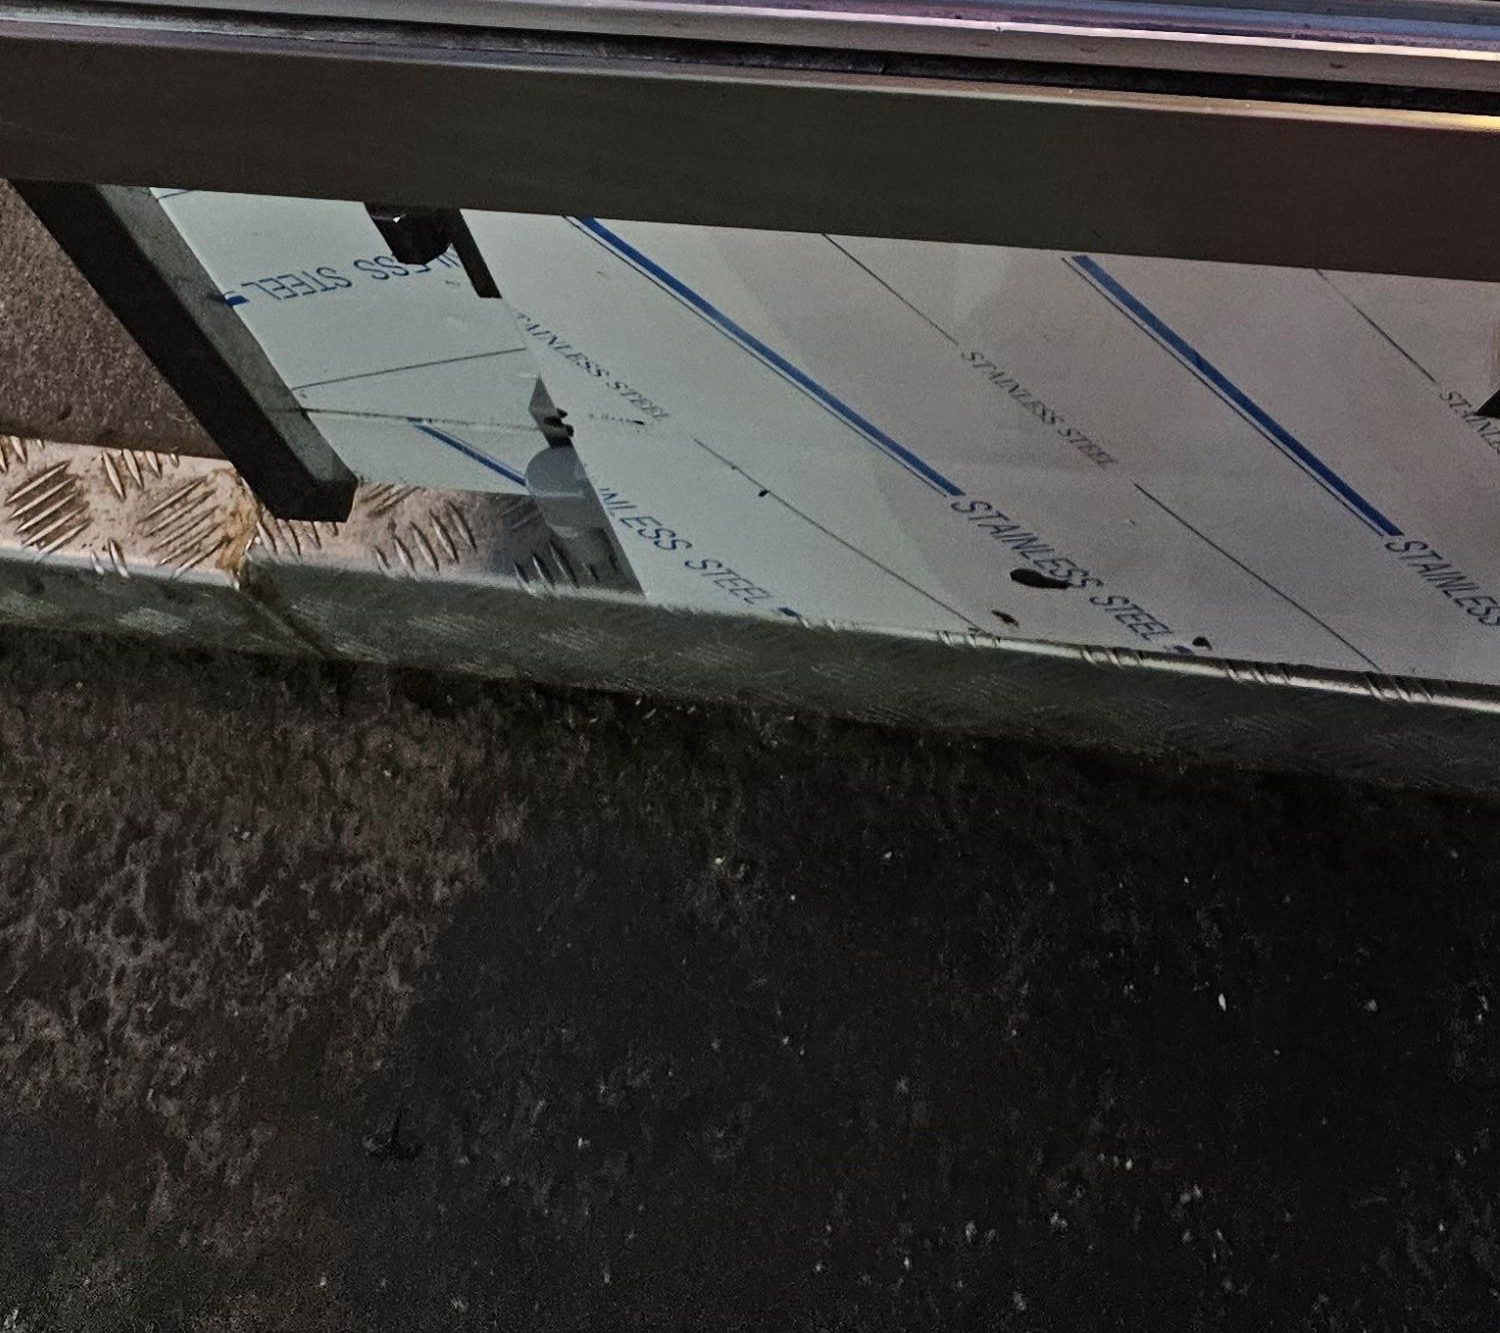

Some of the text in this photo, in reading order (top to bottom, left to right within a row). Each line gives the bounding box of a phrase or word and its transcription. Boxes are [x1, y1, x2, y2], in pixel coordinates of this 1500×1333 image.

[240, 266, 353, 301] STEEL
[684, 558, 775, 606] STEEL
[950, 499, 1174, 641] STAINLESS STEEL
